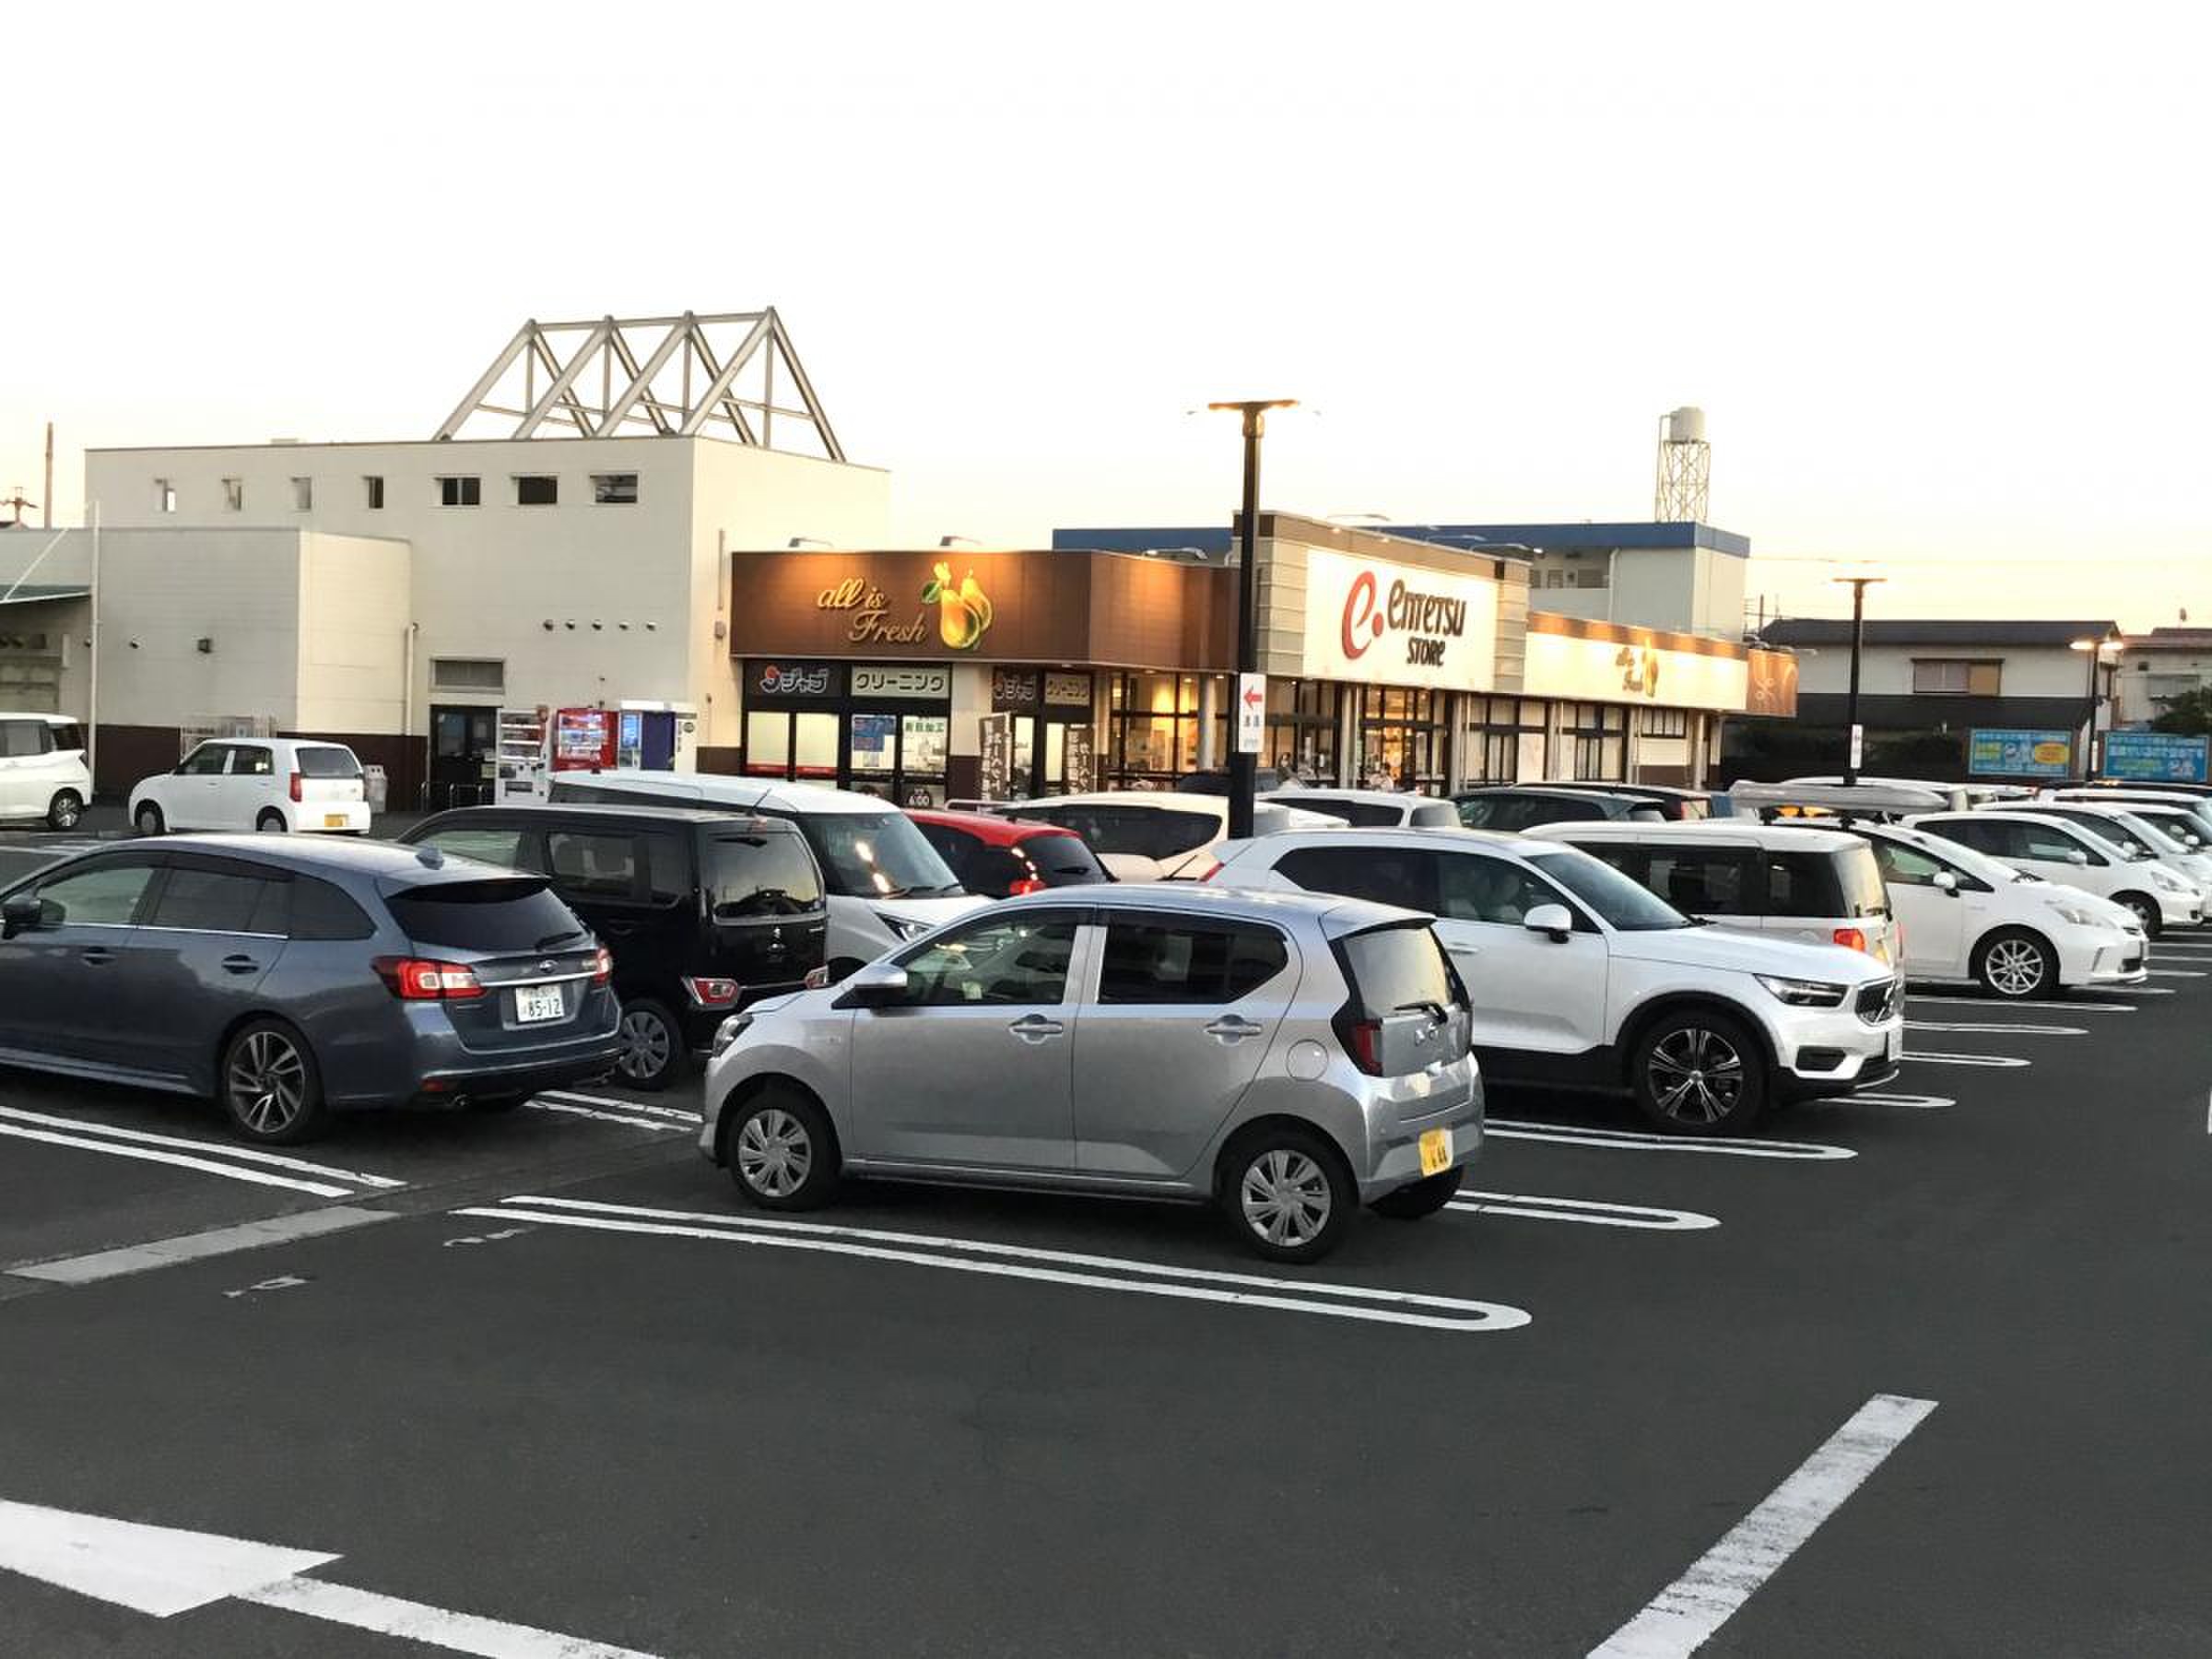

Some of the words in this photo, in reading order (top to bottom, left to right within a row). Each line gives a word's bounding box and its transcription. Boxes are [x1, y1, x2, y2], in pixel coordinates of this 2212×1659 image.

[818, 578, 865, 609] all
[865, 587, 886, 609] is
[848, 609, 927, 643] Fresh
